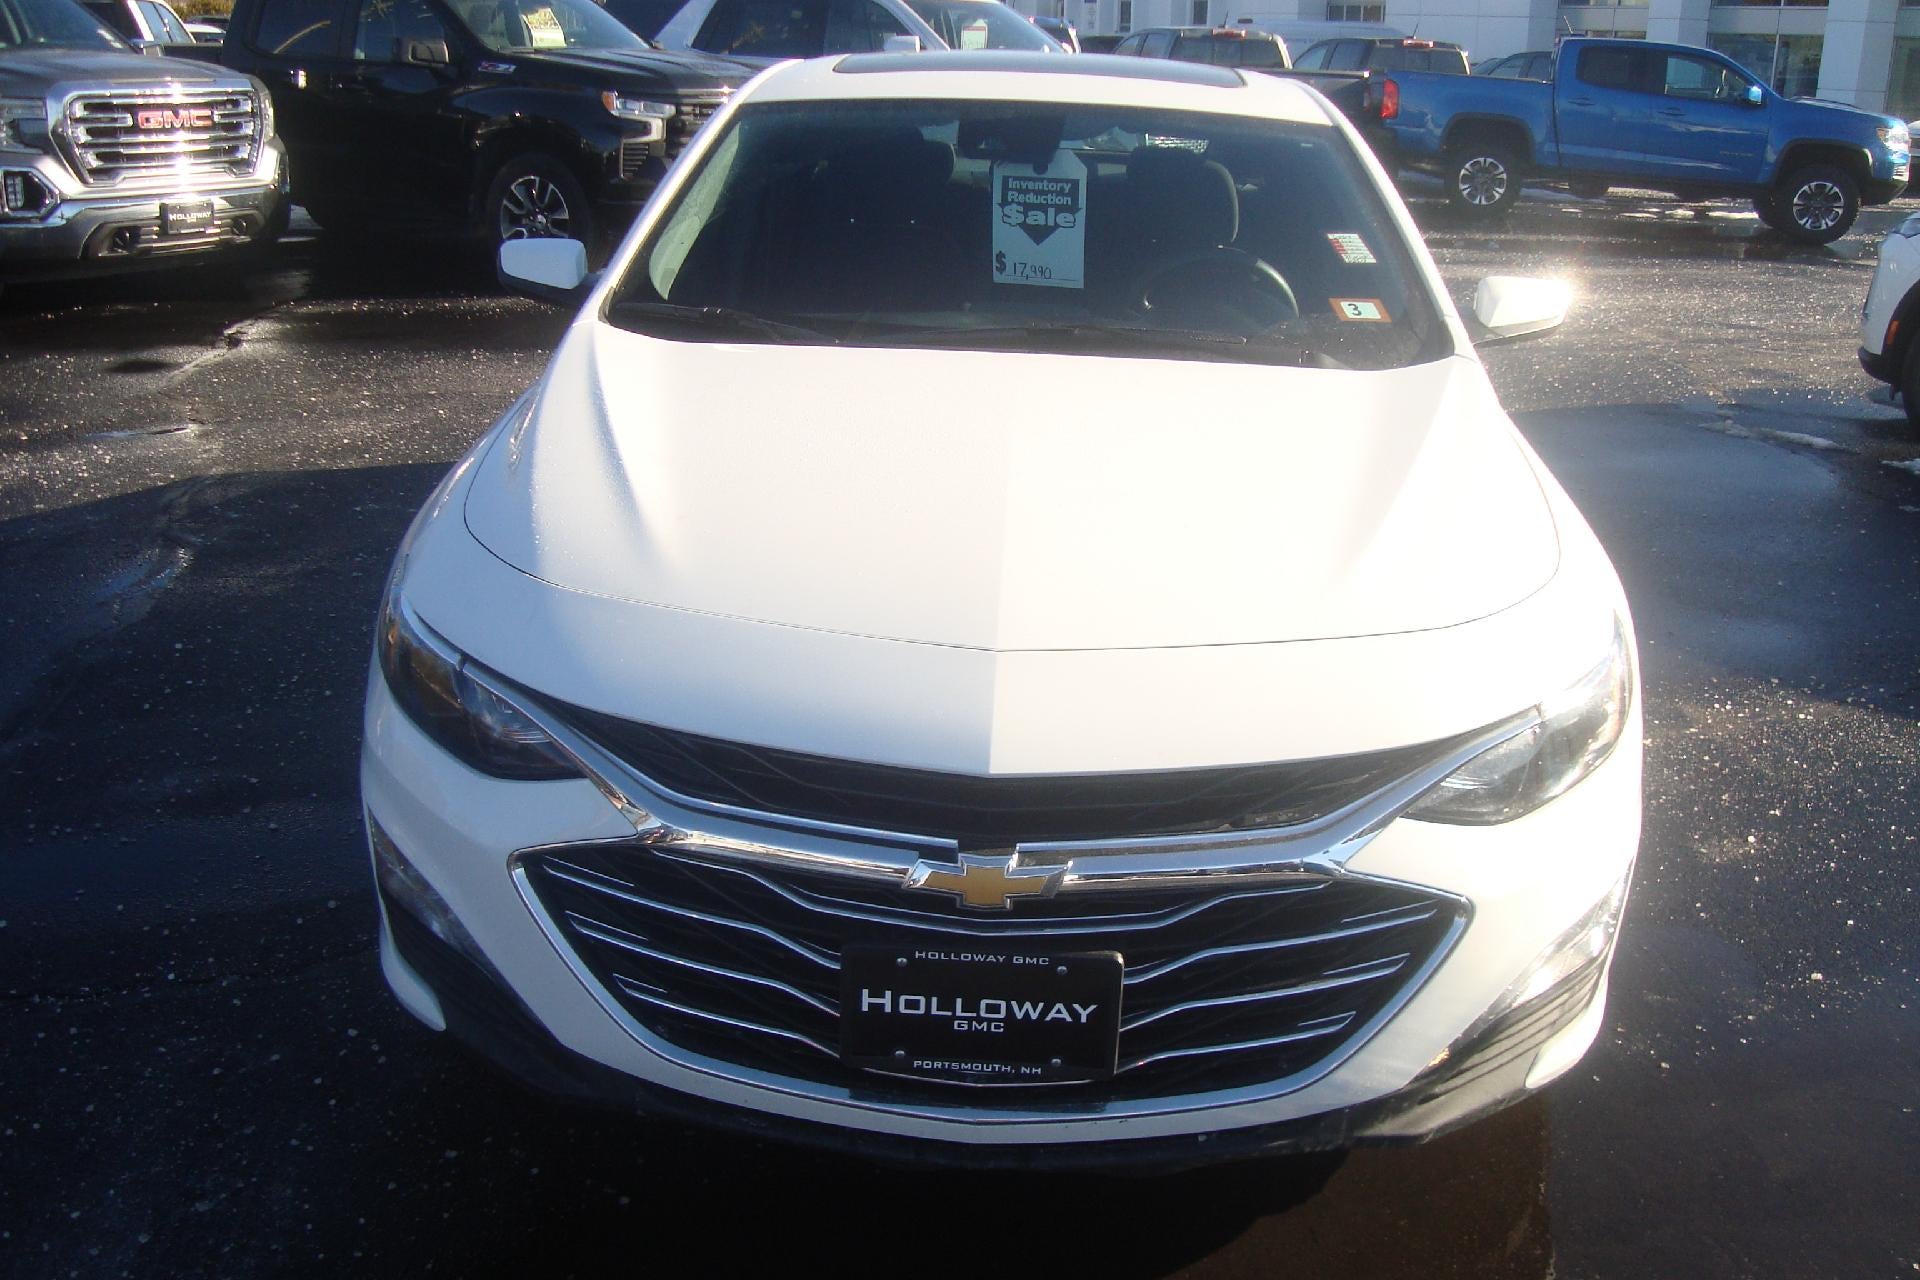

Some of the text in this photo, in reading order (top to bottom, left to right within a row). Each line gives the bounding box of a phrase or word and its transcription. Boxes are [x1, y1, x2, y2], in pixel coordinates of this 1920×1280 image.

[138, 108, 213, 129] GMC
[1008, 178, 1072, 193] Inventory
[1007, 190, 1072, 206] Reduction
[168, 212, 212, 221] HOLLOWAY
[1348, 303, 1362, 316] 3
[915, 950, 1049, 966] HOLLOWAY GMC
[860, 988, 1098, 1024] HOLLOWAY
[953, 1020, 1005, 1033] GMC
[913, 1060, 1042, 1076] PORTSMOUTH, NH
